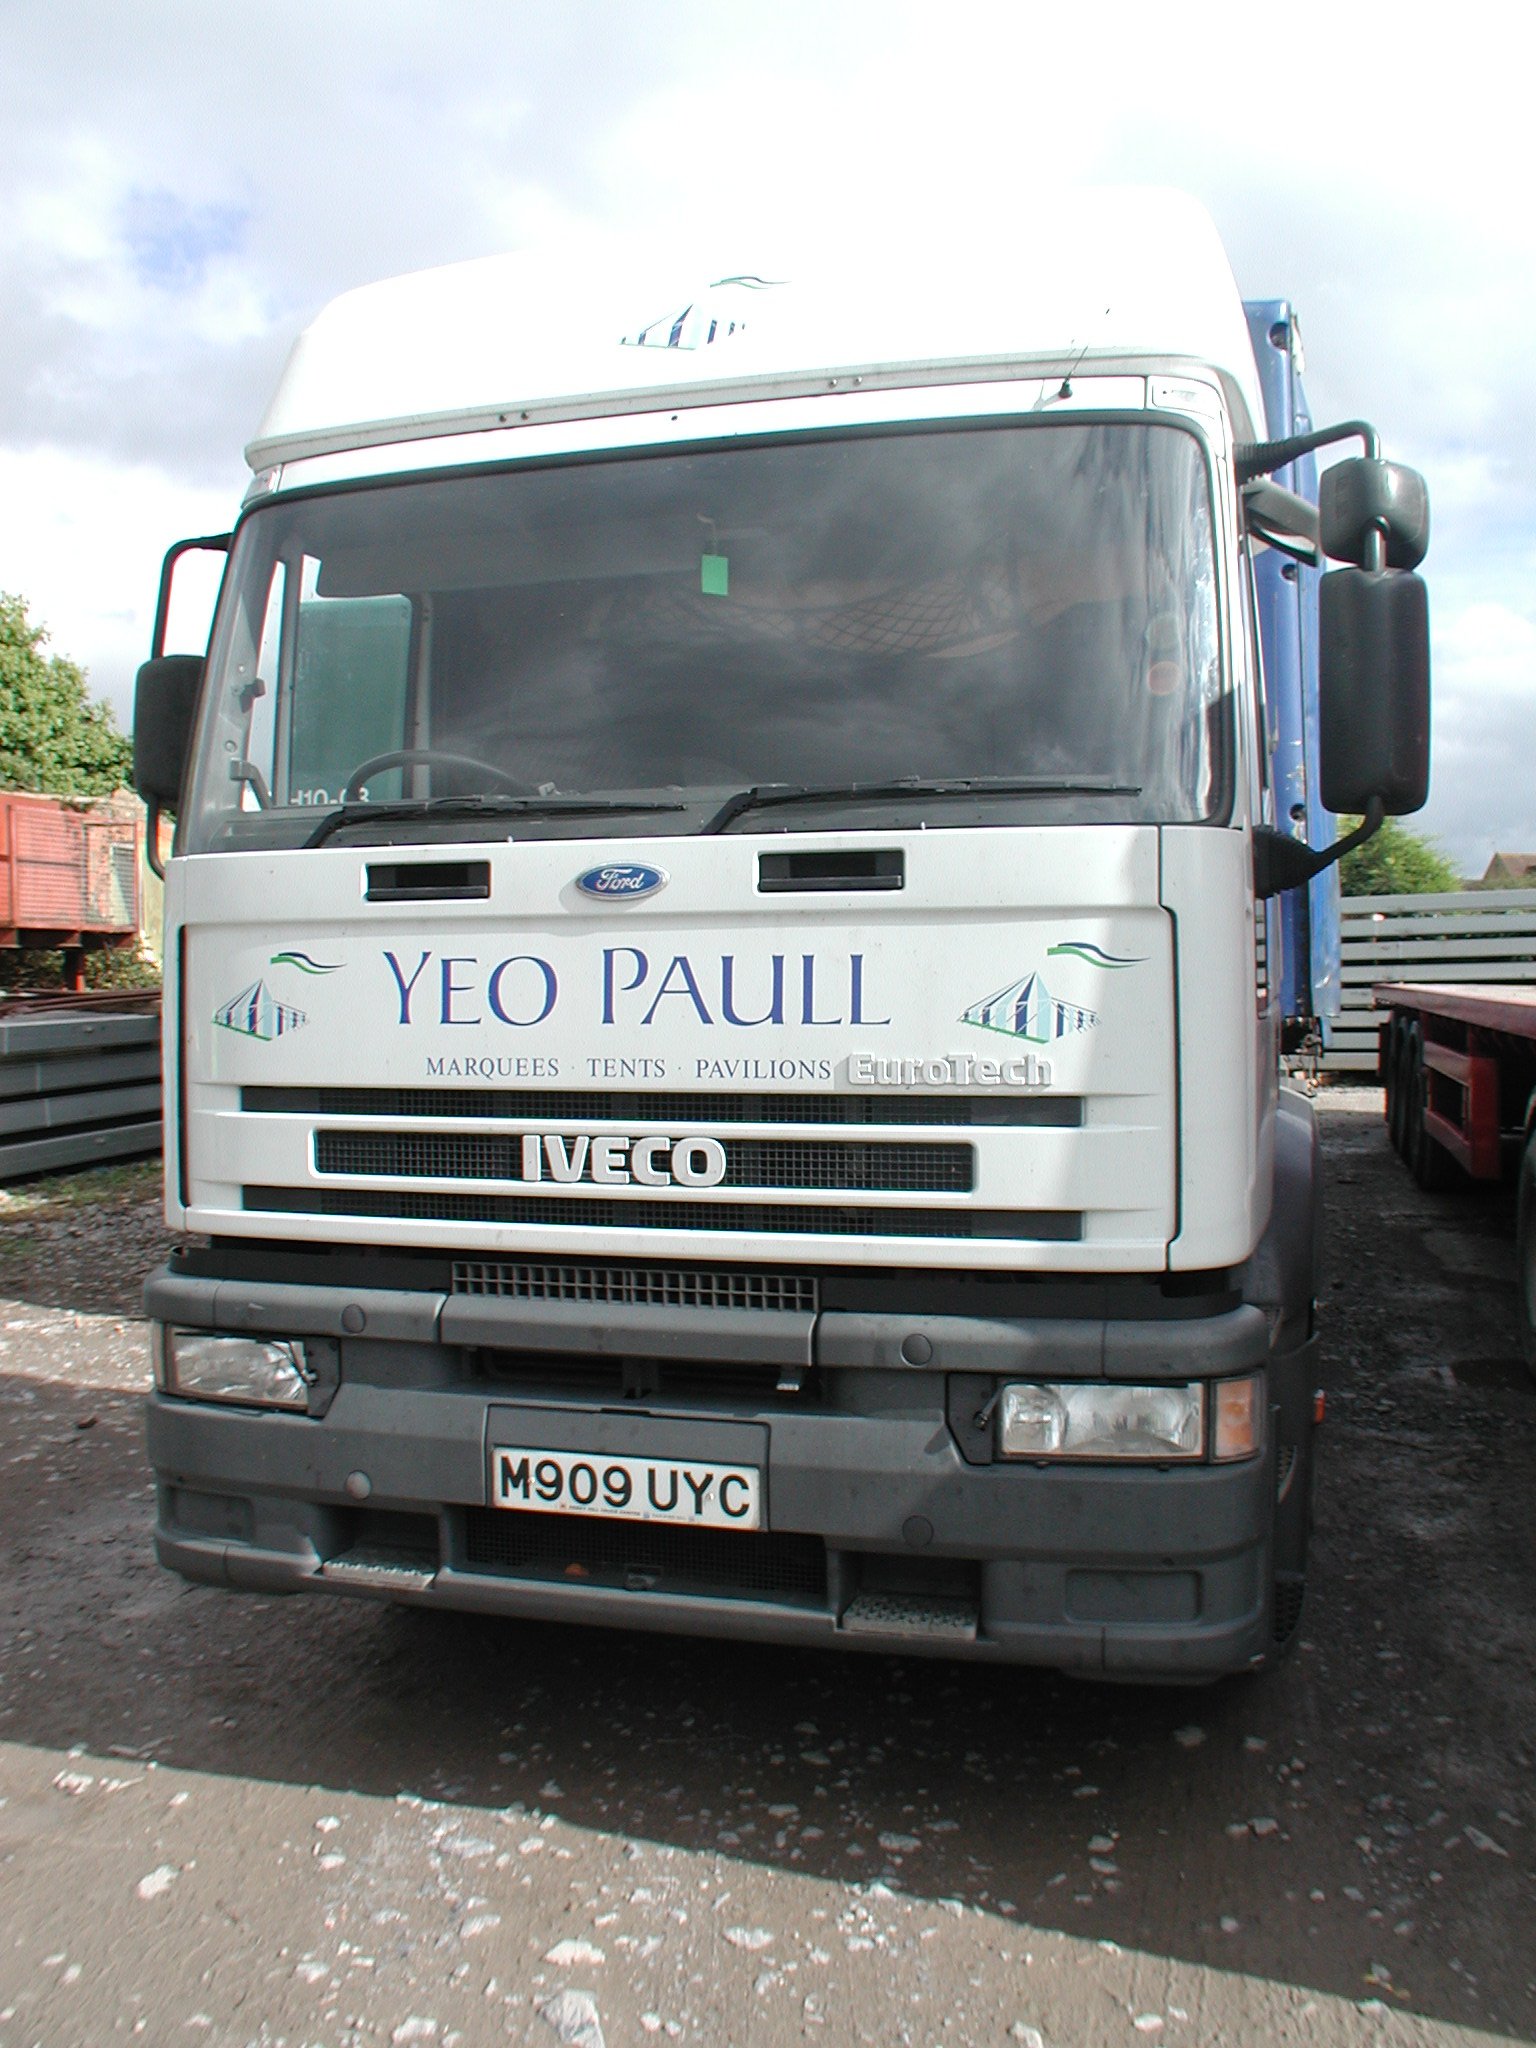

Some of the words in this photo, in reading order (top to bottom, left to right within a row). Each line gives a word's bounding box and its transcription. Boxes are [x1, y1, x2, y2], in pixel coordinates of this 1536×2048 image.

[594, 867, 646, 891] Ford
[383, 951, 558, 1027] YEO
[601, 947, 892, 1027] PAULL
[426, 1057, 560, 1081] MARQUEES
[586, 1057, 666, 1078] TENTS
[695, 1058, 832, 1081] PAVILIONS
[848, 1052, 1053, 1087] EuroTech
[521, 1134, 727, 1187] IVECO
[500, 1455, 634, 1509] M909
[647, 1467, 751, 1519] UYC
